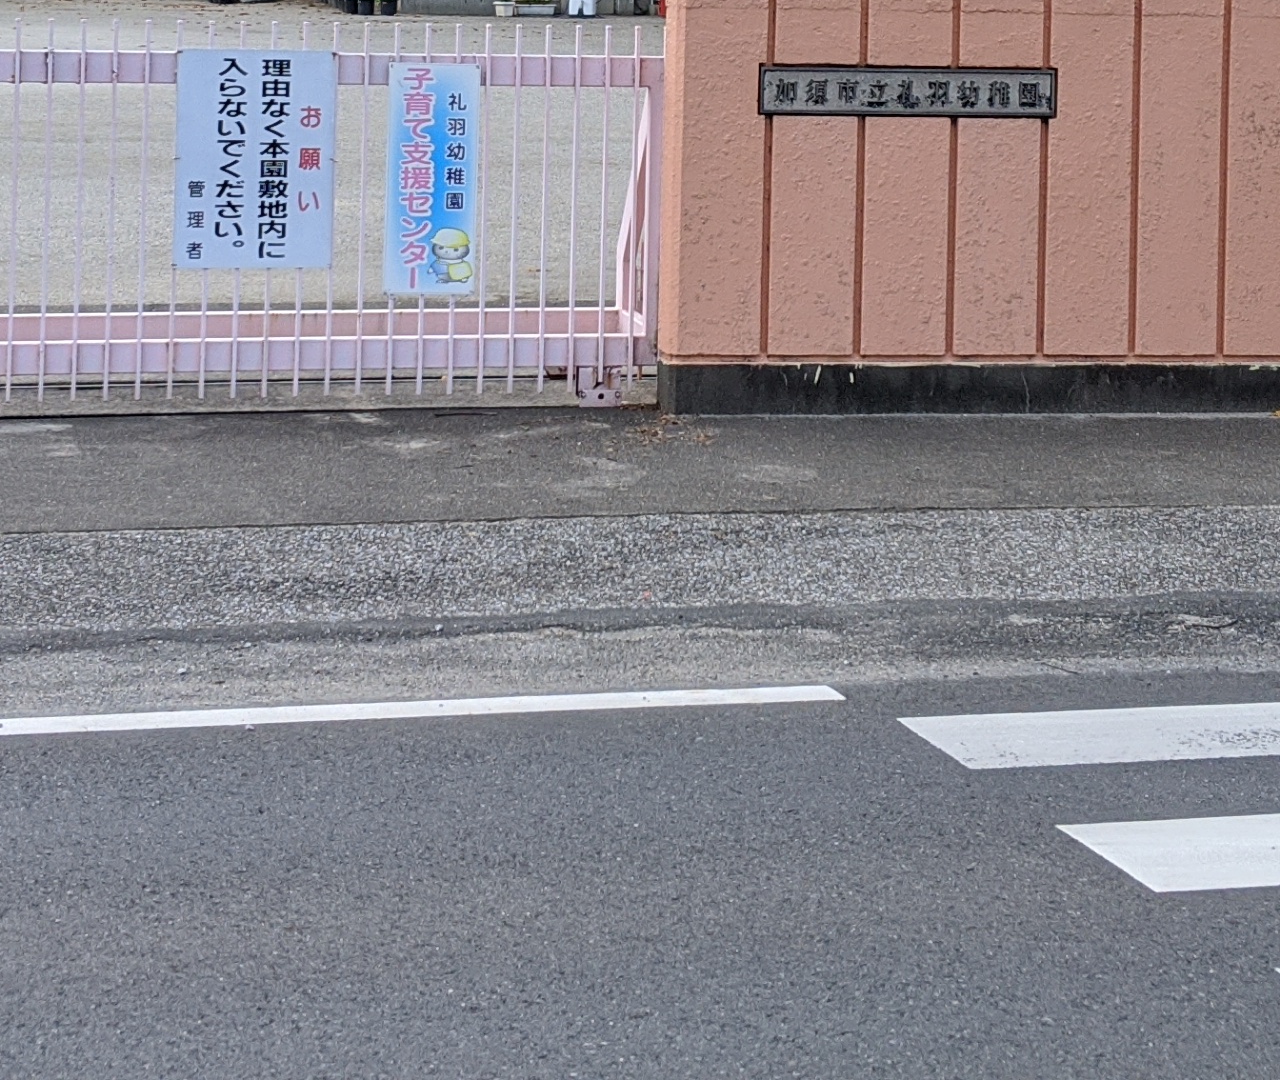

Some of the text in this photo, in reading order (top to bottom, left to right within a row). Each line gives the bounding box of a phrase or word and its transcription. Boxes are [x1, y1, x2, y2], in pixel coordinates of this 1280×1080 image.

[446, 92, 467, 210] 礼羽幼稚園
[773, 77, 1041, 109] 加須市立礼羽幼稚園
[214, 57, 249, 248] 入らないでください。
[257, 58, 292, 259] 理由なく本園敷地内に
[298, 105, 322, 212] お願い
[400, 68, 434, 289] 子育て支援センター
[186, 180, 206, 260] 管理者
